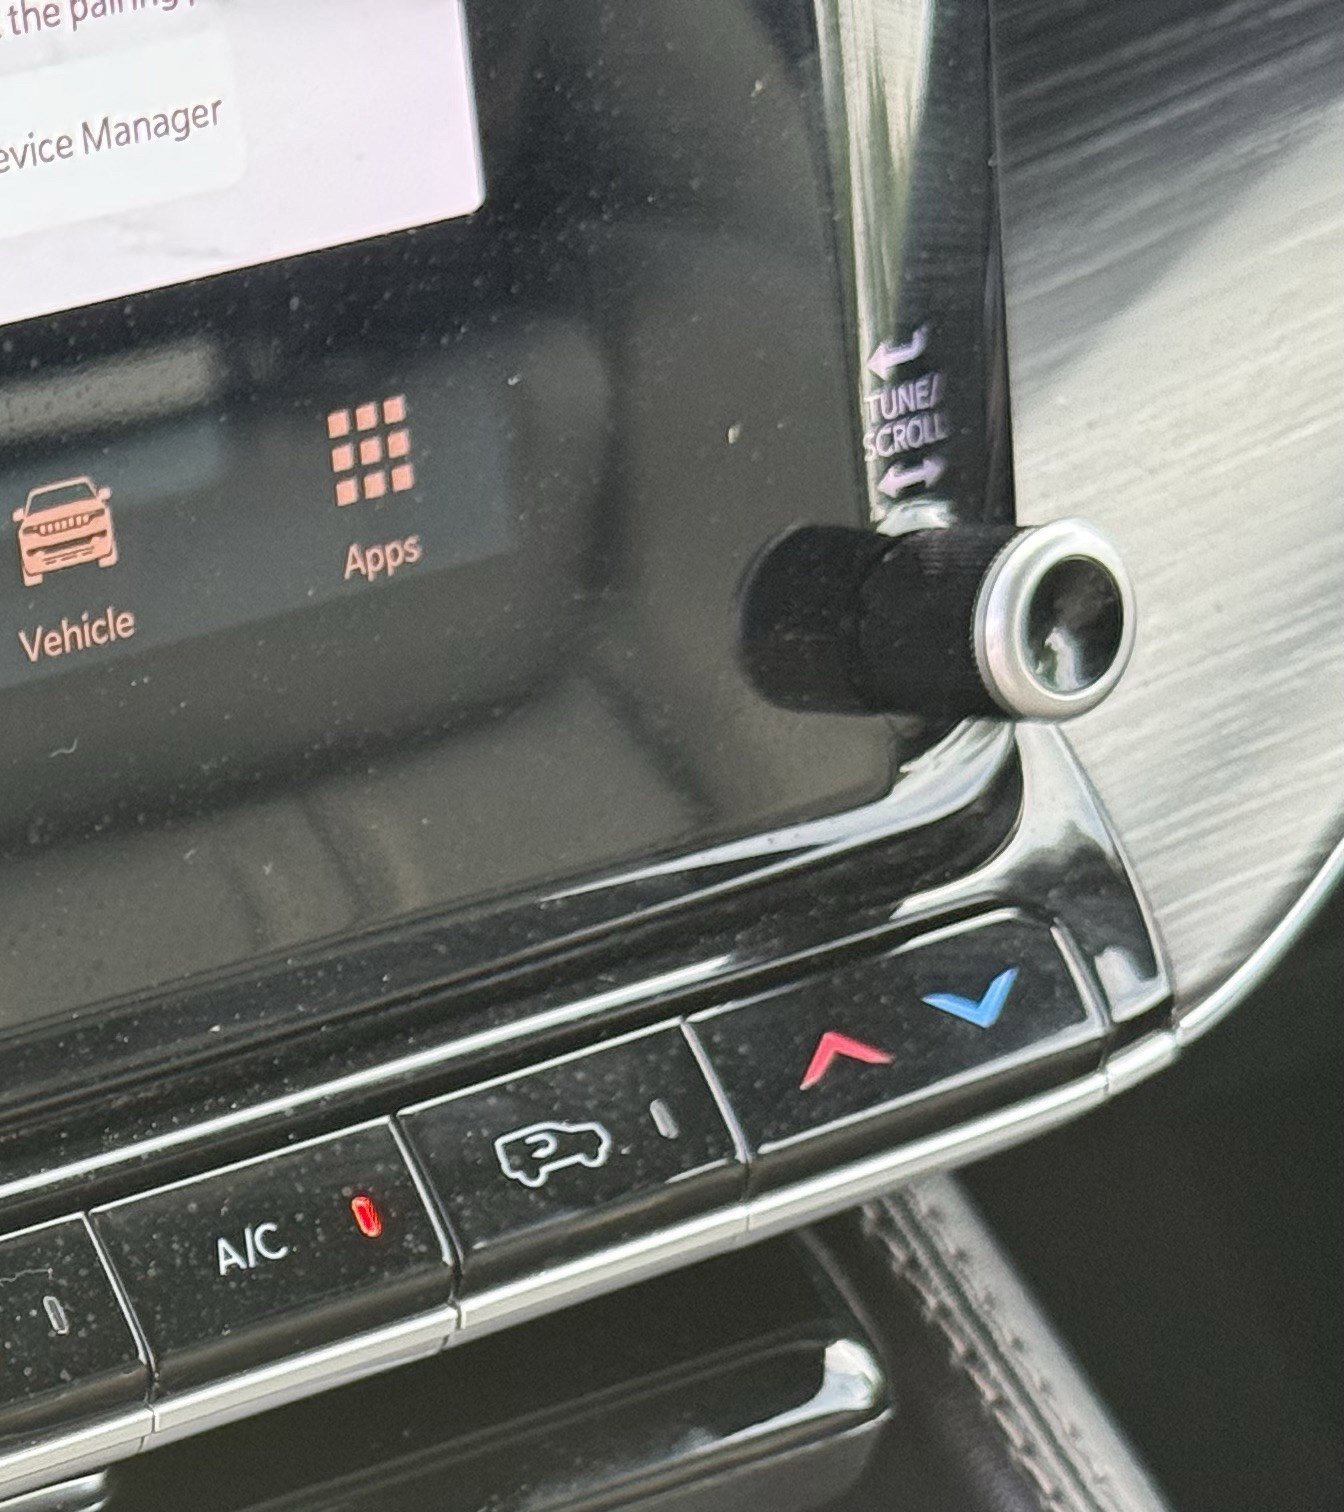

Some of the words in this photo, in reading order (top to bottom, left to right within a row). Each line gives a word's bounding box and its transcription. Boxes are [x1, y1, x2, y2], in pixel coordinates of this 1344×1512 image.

[7, 0, 62, 35] the
[81, 97, 223, 156] Manager
[864, 371, 941, 422] TUNE/
[863, 412, 949, 463] SCROLL
[343, 533, 423, 580] Apps
[18, 605, 137, 663] Vehicle
[215, 1221, 291, 1278] A/C
